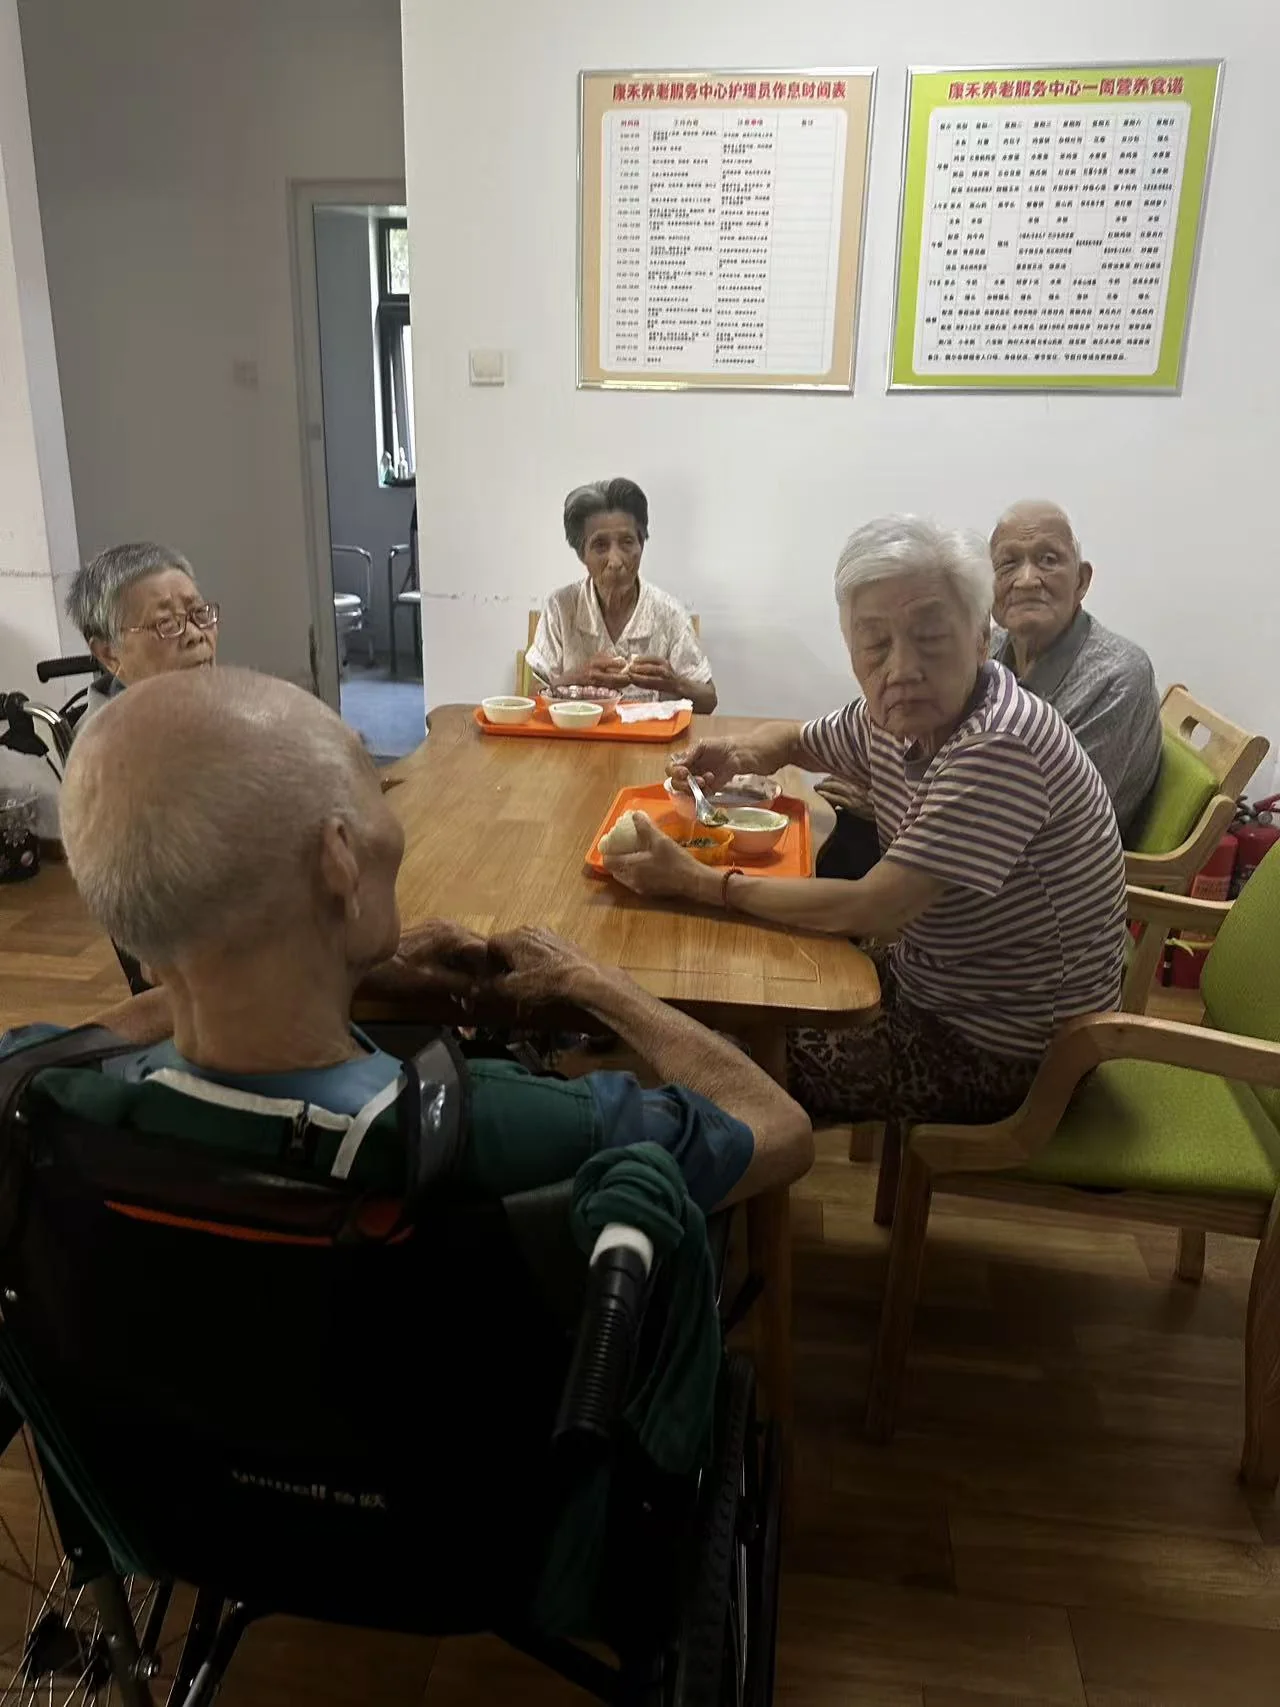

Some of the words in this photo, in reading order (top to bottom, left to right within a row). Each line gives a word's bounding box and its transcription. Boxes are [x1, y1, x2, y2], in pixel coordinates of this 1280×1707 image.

[612, 81, 847, 101] 康禾养老服务中心护理员作息时间表
